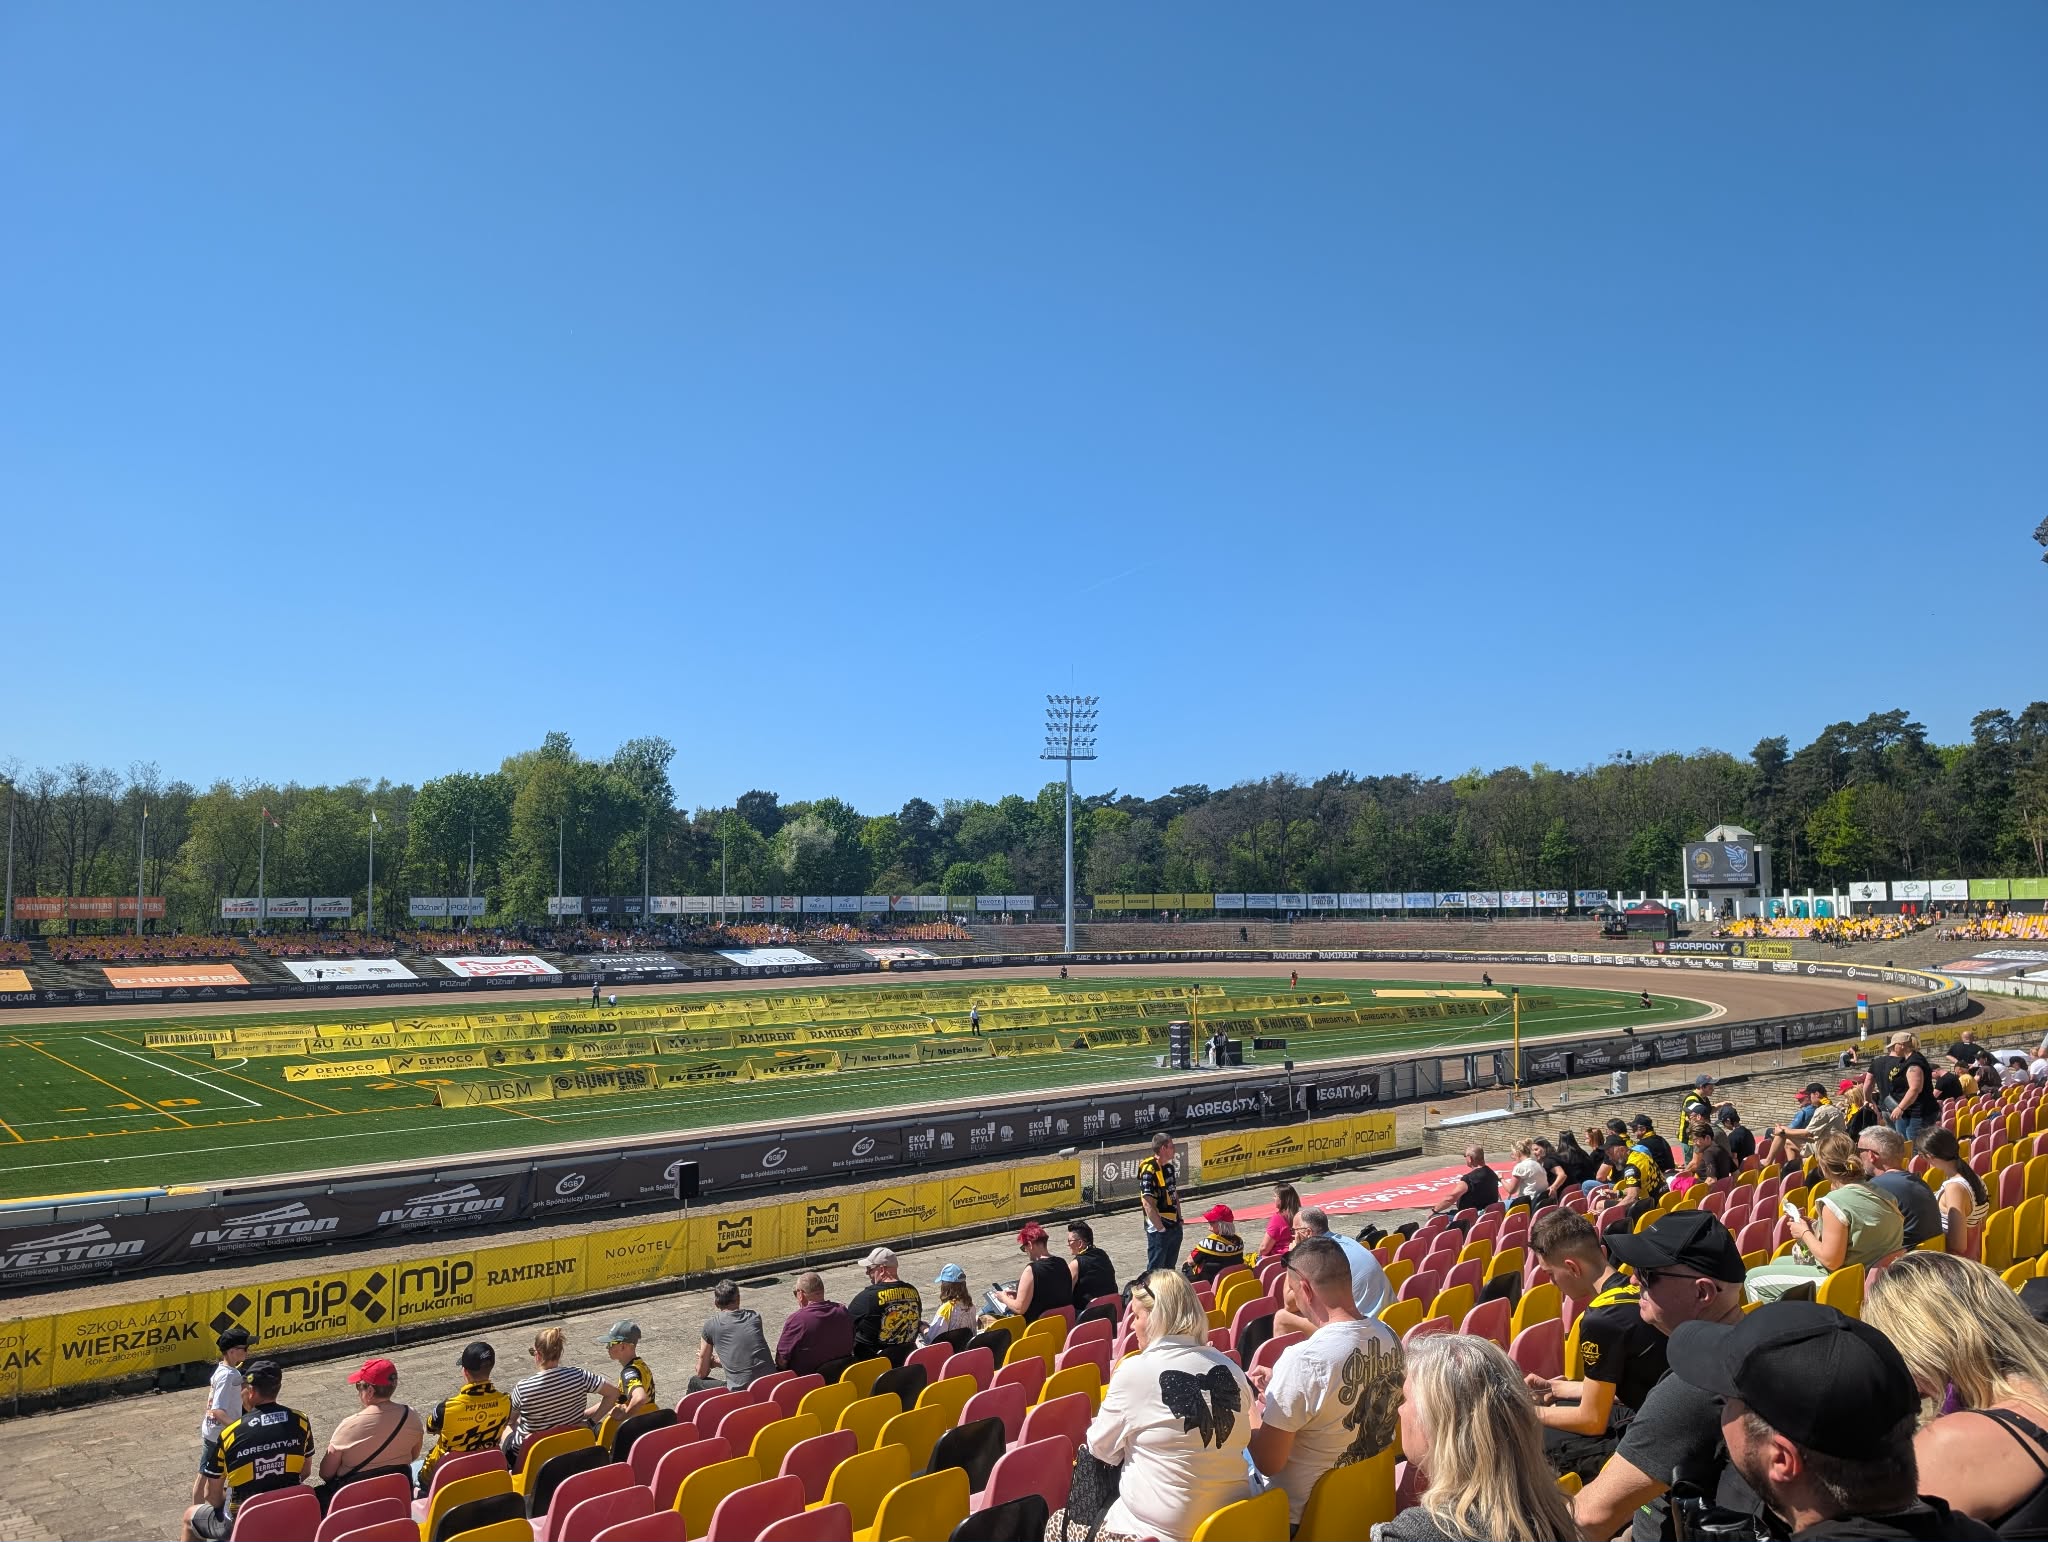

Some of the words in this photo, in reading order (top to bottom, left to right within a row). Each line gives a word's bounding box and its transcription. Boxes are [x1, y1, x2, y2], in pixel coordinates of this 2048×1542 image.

[1443, 894, 1464, 903] ATL
[129, 902, 162, 911] HUTERS
[1669, 941, 1726, 951] SKORPIONY
[1272, 952, 1313, 960] RAMIRENT
[1319, 951, 1359, 960] RAMIRENT
[140, 975, 239, 984] HUNTERS
[0, 993, 36, 1001] OL-CAR
[872, 1022, 929, 1033] BLACKWATER
[1269, 1016, 1307, 1028] HUNTERS
[739, 1031, 797, 1044] RAMIRENT
[809, 1027, 863, 1039] RAMIRENT
[1100, 1029, 1139, 1042] HUNTERS
[313, 1038, 334, 1049] 4U
[342, 1037, 364, 1047] 4U
[371, 1036, 391, 1046] 4U
[937, 1045, 983, 1056] Metalkas
[419, 1054, 473, 1066] DEMOCO
[861, 1052, 912, 1063] Metalkas
[315, 1064, 375, 1074] DEMOCO
[763, 1062, 826, 1074] IVESTON
[575, 1069, 646, 1089] HUNTERS
[668, 1070, 738, 1082] IVESTON
[488, 1081, 533, 1099] DSM
[1028, 1121, 1043, 1129] EKO
[1258, 1144, 1304, 1158] IVESTON
[1203, 1151, 1253, 1167] IVESTON
[787, 1165, 808, 1174] Duszniki
[563, 1180, 579, 1189] SGB
[640, 1185, 654, 1193] Bank
[584, 1191, 611, 1202] Duszniki
[955, 1194, 977, 1206] INVEST
[977, 1192, 999, 1203] HOUSE
[377, 1196, 505, 1225] IVESTON
[877, 1208, 901, 1219] INVEST
[902, 1204, 926, 1215] HOUSE
[806, 1213, 839, 1228] TERRAZZO
[190, 1216, 340, 1245] IVESTON
[717, 1227, 752, 1241] TERRAZZO
[267, 1236, 295, 1247] budowa
[296, 1234, 312, 1245] dróg
[0, 1239, 146, 1269] VESTON
[605, 1239, 672, 1260] NOVOTEL
[2, 1265, 59, 1279] kompleksowa
[61, 1261, 93, 1273] budowa
[94, 1258, 113, 1271] dróg
[487, 1257, 577, 1287] RAMIRENT
[399, 1259, 474, 1298] mjp
[264, 1280, 348, 1319] mjp
[398, 1293, 473, 1317] drukarnia
[76, 1316, 137, 1337] SZKOŁA
[141, 1308, 188, 1327] JAZDY
[263, 1315, 347, 1340] drukarnia
[0, 1334, 29, 1348] ZDY
[61, 1321, 200, 1360] WIERZBAK
[84, 1356, 104, 1368] Rok
[151, 1343, 177, 1356] 1990
[0, 1370, 17, 1381] 990
[255, 1460, 285, 1473] TERRAZZO
